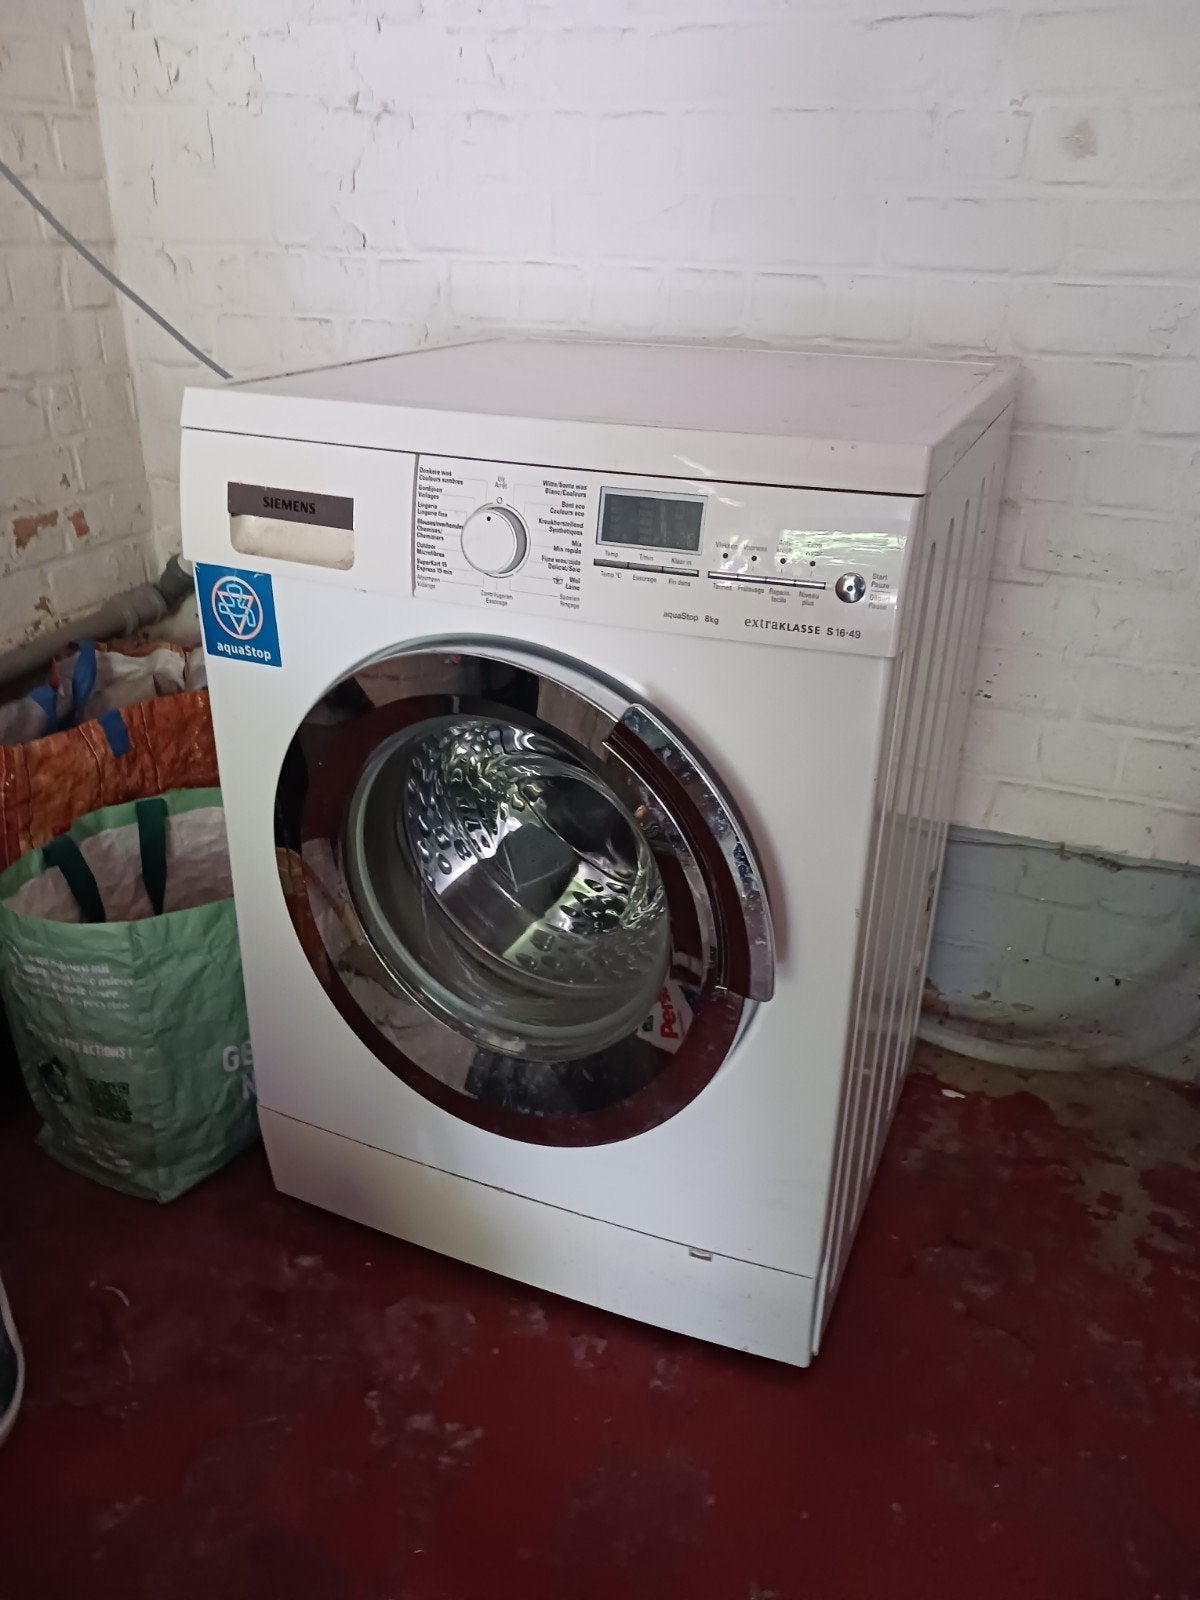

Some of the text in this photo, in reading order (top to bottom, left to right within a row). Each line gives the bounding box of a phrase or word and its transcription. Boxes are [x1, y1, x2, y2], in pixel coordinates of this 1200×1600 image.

[419, 474, 441, 482] Couleurs
[545, 488, 586, 498] Blanc/Couleurs
[263, 497, 316, 515] SIEMENS
[550, 507, 573, 516] Couleurs
[605, 550, 618, 558] Temp
[633, 574, 657, 583] Essorage
[566, 583, 580, 591] Laine
[663, 611, 719, 626] aquaStop 8kg
[744, 617, 821, 635] extraKLASSE
[217, 641, 271, 662] aquaStop
